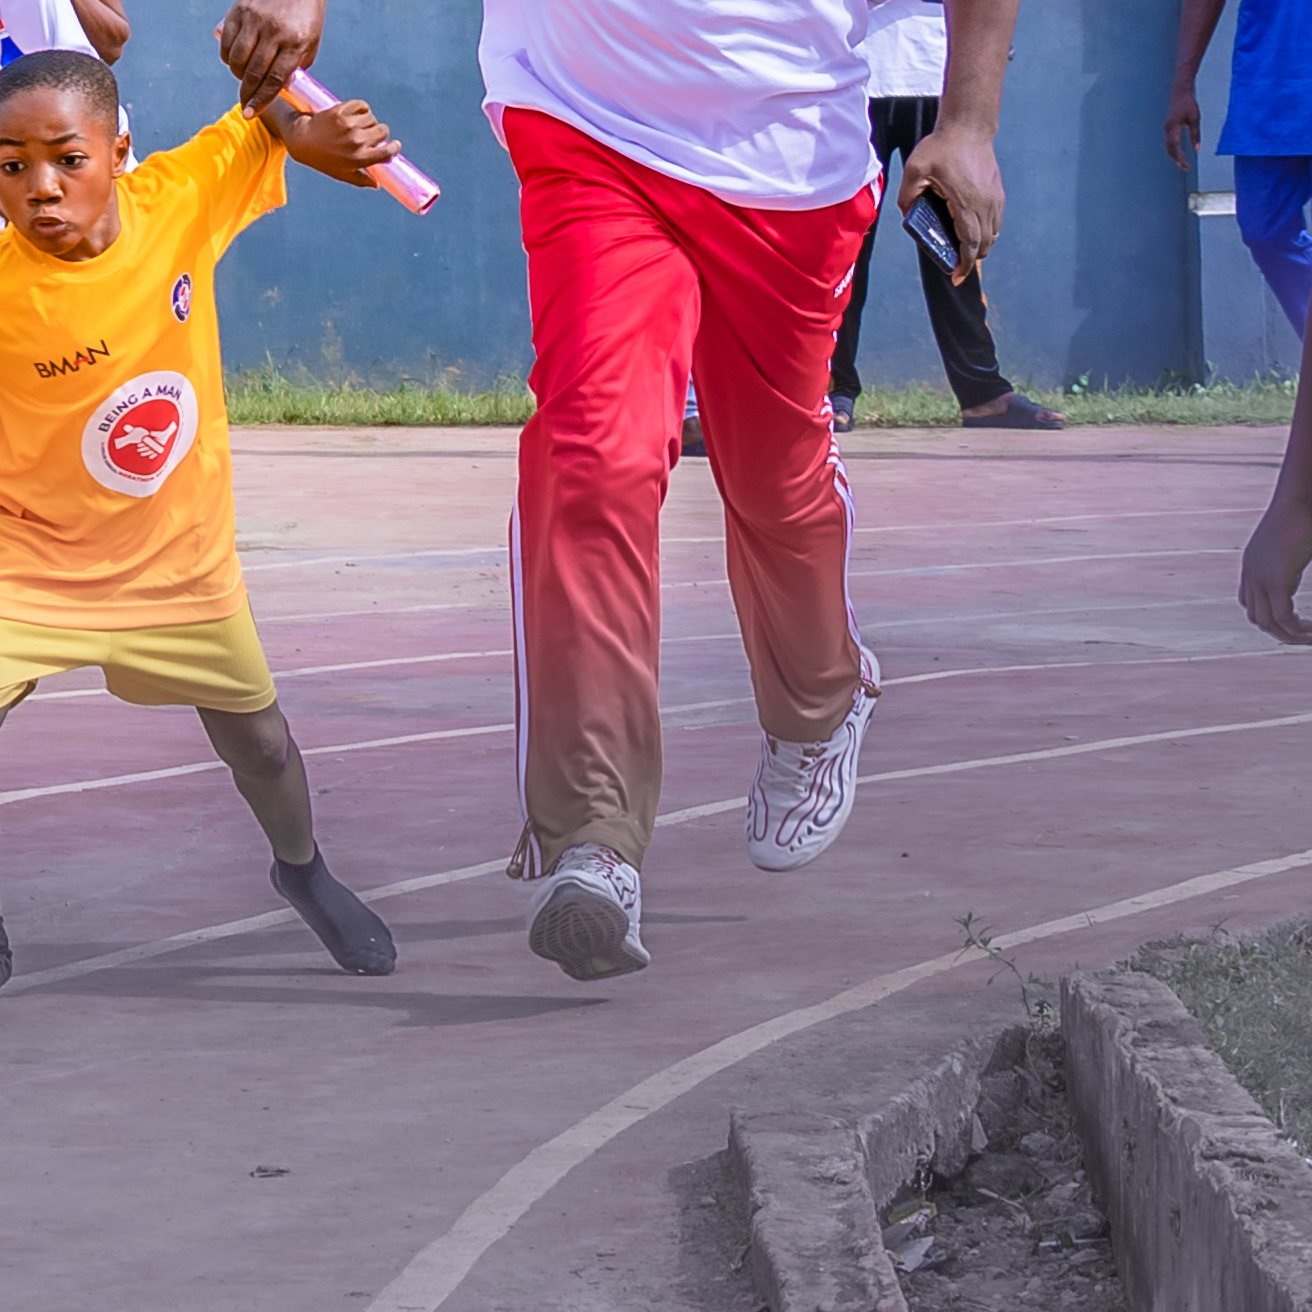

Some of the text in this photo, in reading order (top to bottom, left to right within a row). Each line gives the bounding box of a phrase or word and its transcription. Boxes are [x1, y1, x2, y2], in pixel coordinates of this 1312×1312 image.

[33, 339, 110, 378] BMAN
[97, 384, 182, 433] BEING A MAN
